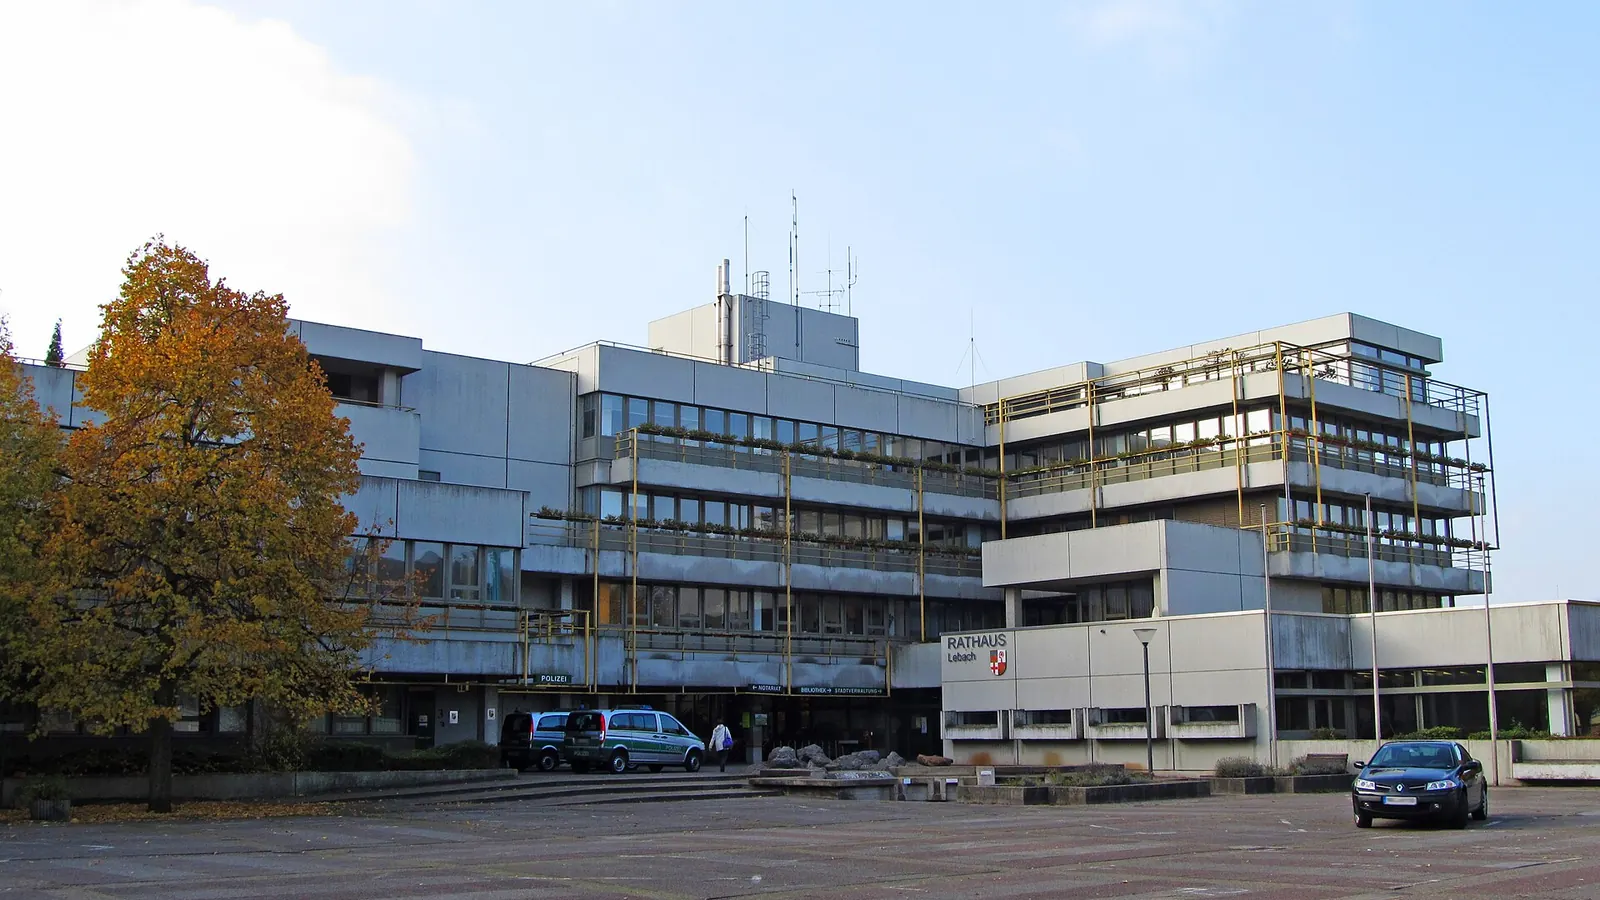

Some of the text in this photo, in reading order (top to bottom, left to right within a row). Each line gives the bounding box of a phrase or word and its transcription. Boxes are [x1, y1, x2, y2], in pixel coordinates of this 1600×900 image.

[947, 633, 1007, 650] RATHAUS
[947, 651, 977, 663] Lebach
[541, 674, 567, 683] POLIZEI
[800, 686, 828, 694] BIBLIOTHEK
